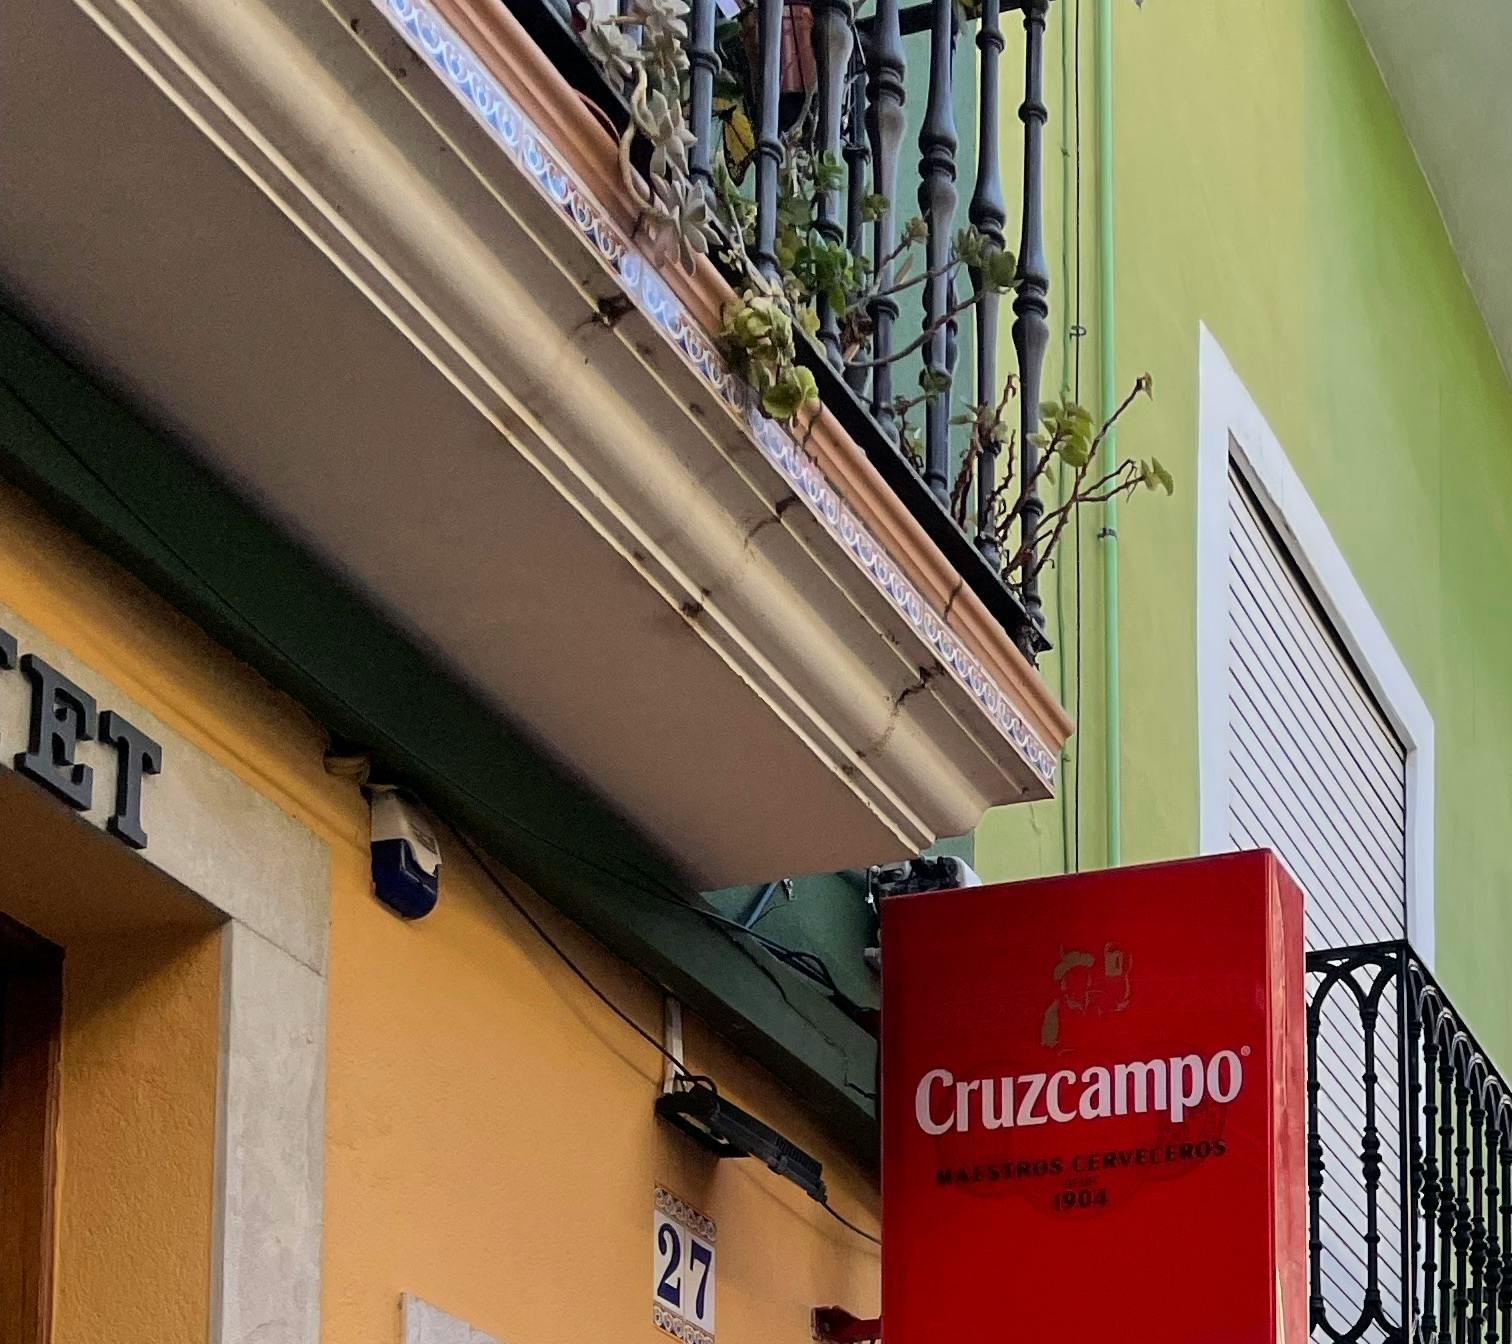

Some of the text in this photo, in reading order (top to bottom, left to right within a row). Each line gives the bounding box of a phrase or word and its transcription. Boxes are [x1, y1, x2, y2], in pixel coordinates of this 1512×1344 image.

[0, 627, 162, 849] ET
[915, 1048, 1244, 1137] Cruzcampo
[935, 1139, 1228, 1187] MAESTROS CERVECEROS
[1053, 1187, 1109, 1212] 1904
[657, 1222, 712, 1320] 27
